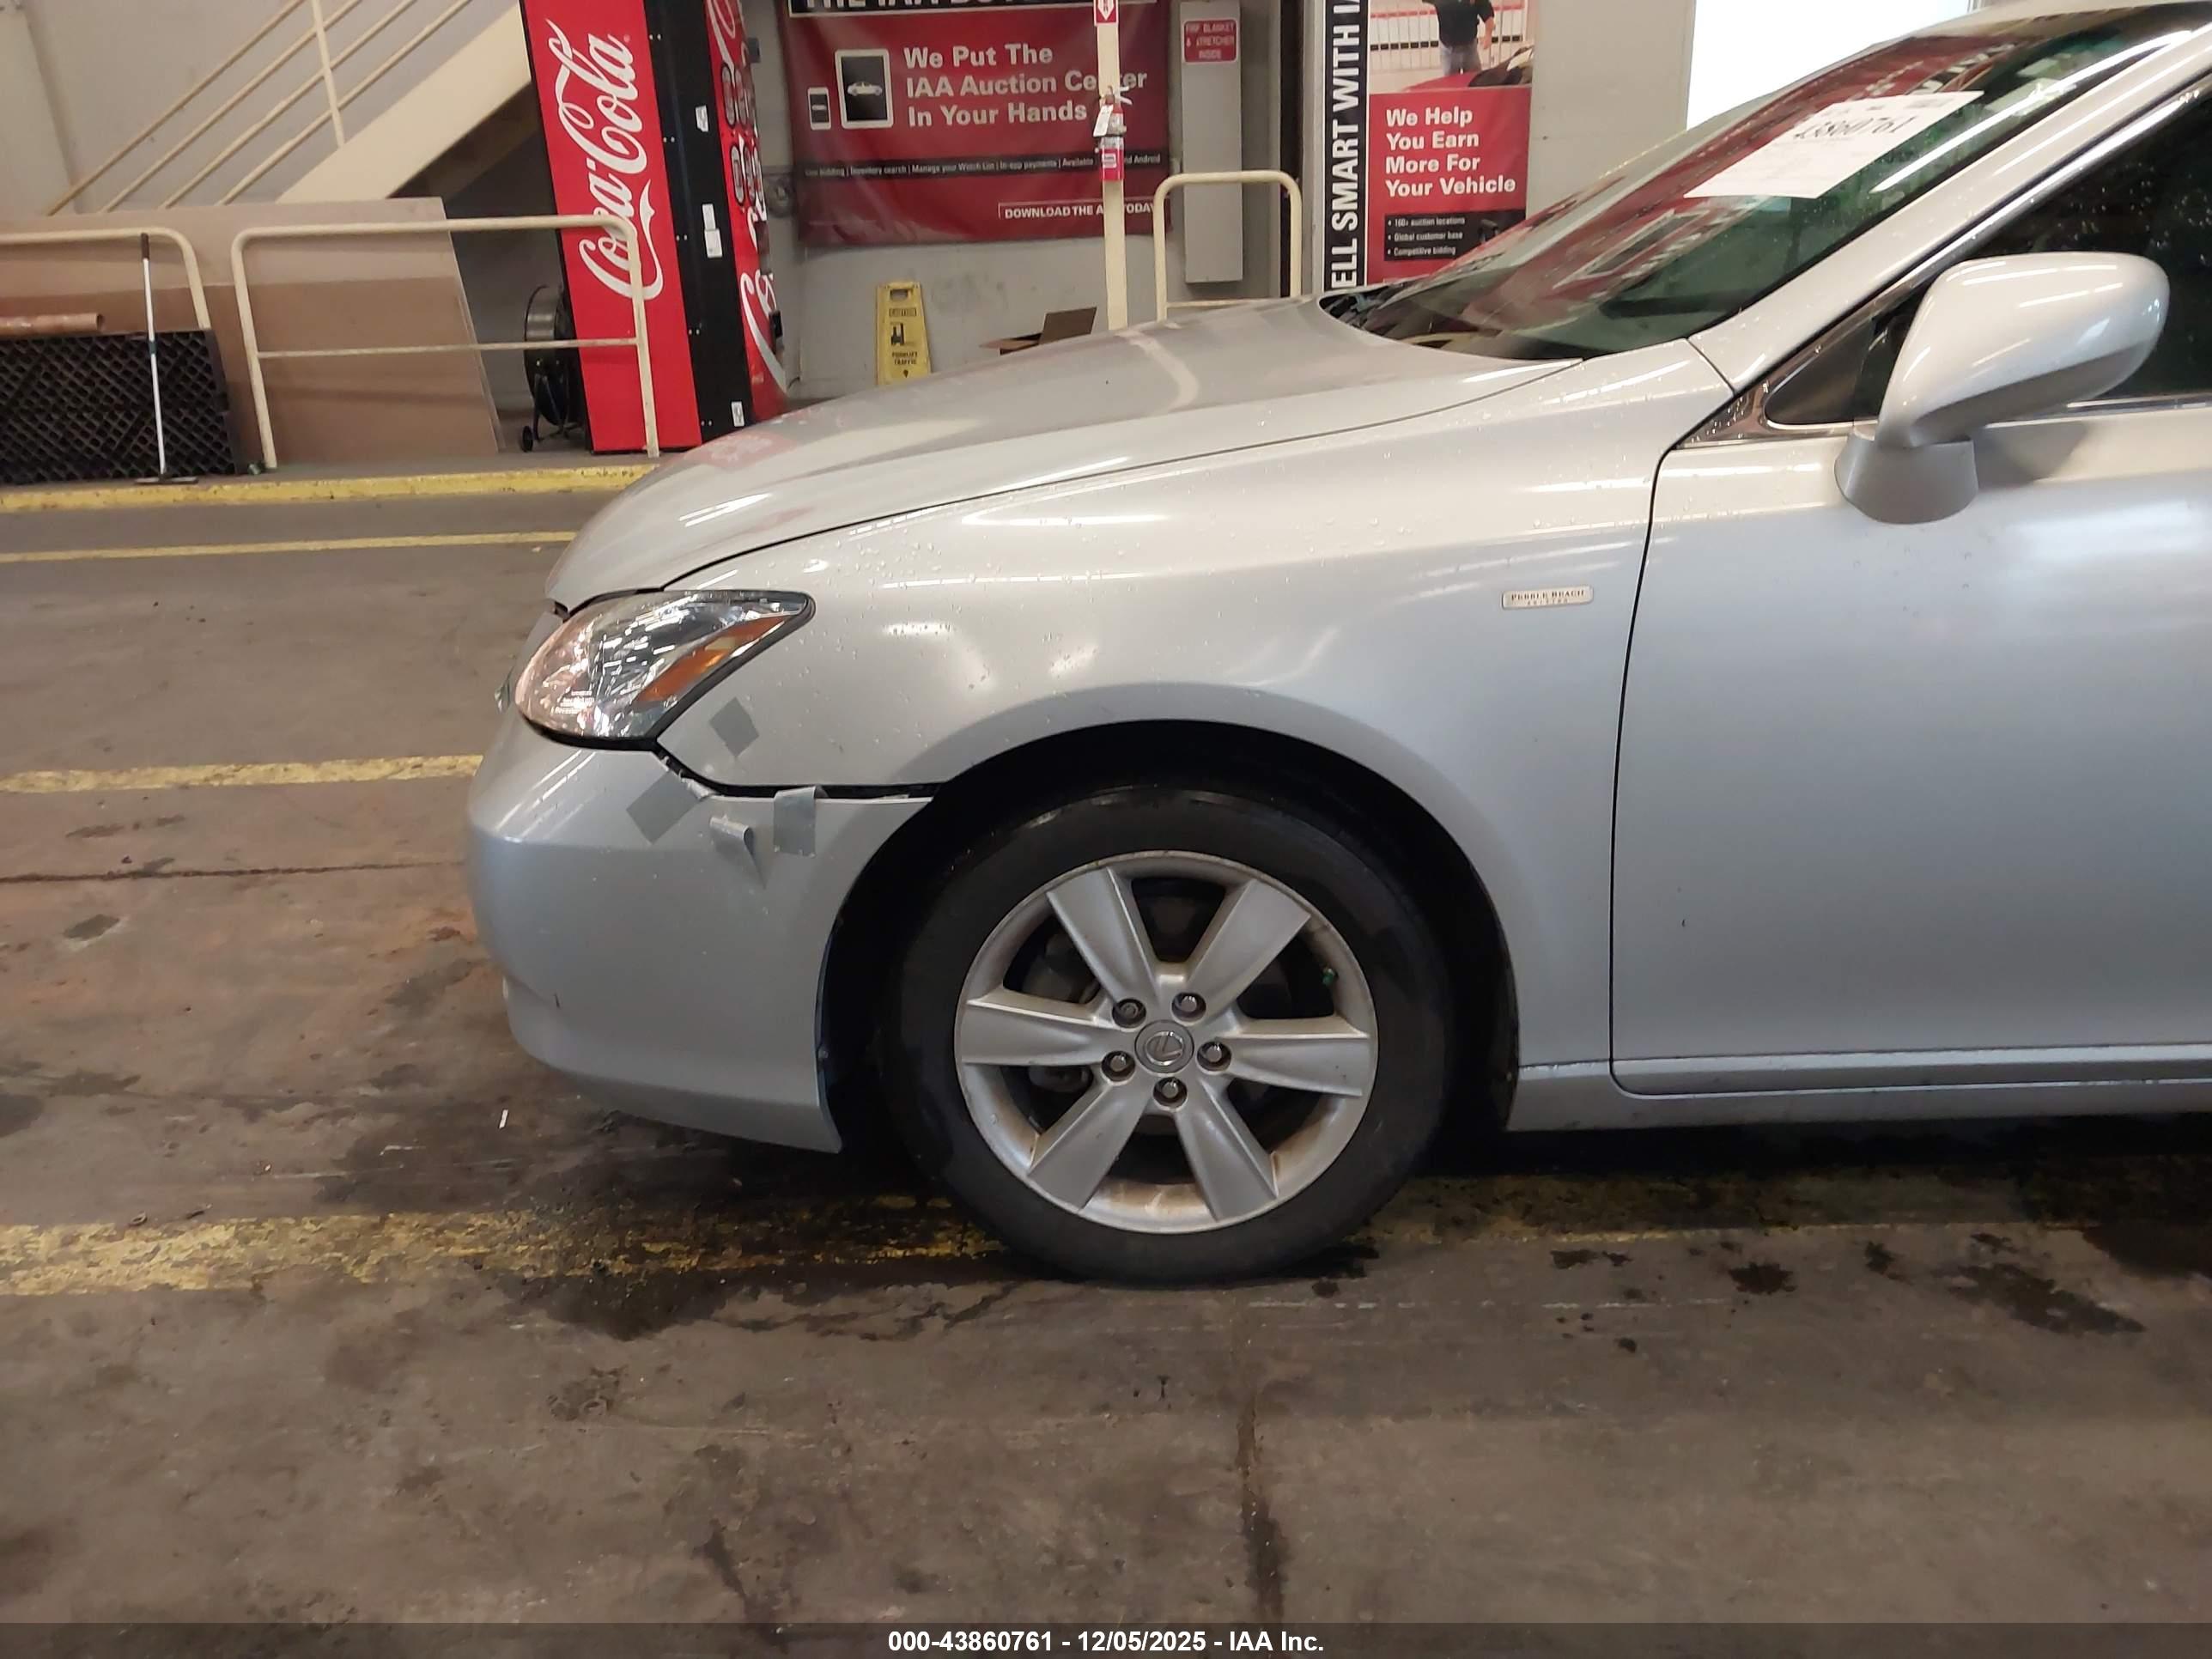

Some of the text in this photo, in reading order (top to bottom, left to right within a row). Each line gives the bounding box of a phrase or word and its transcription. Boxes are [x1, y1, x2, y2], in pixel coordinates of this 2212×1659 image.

[903, 43, 1053, 69] We Put The
[1333, 24, 1360, 112] WITH
[906, 70, 1147, 98] IAA Auction Ceer
[908, 100, 1087, 127] In Your Hands
[1386, 106, 1473, 128] We Help
[1386, 131, 1479, 151] You Earn
[912, 164, 940, 174] Manage
[1134, 154, 1160, 163] Android
[1385, 153, 1480, 174] More For
[1332, 119, 1358, 232] SMART
[1385, 174, 1516, 198] Your Vehicle
[1005, 206, 1071, 220] DOWNLOAD
[1072, 205, 1094, 216] THE
[1124, 203, 1154, 214] ODA
[1436, 216, 1465, 225] locations
[1394, 231, 1463, 241] Global customer base
[1394, 246, 1456, 257] Competitive bidding
[1332, 238, 1358, 289] ELL
[1511, 590, 1584, 601] PEBBLE BEACH
